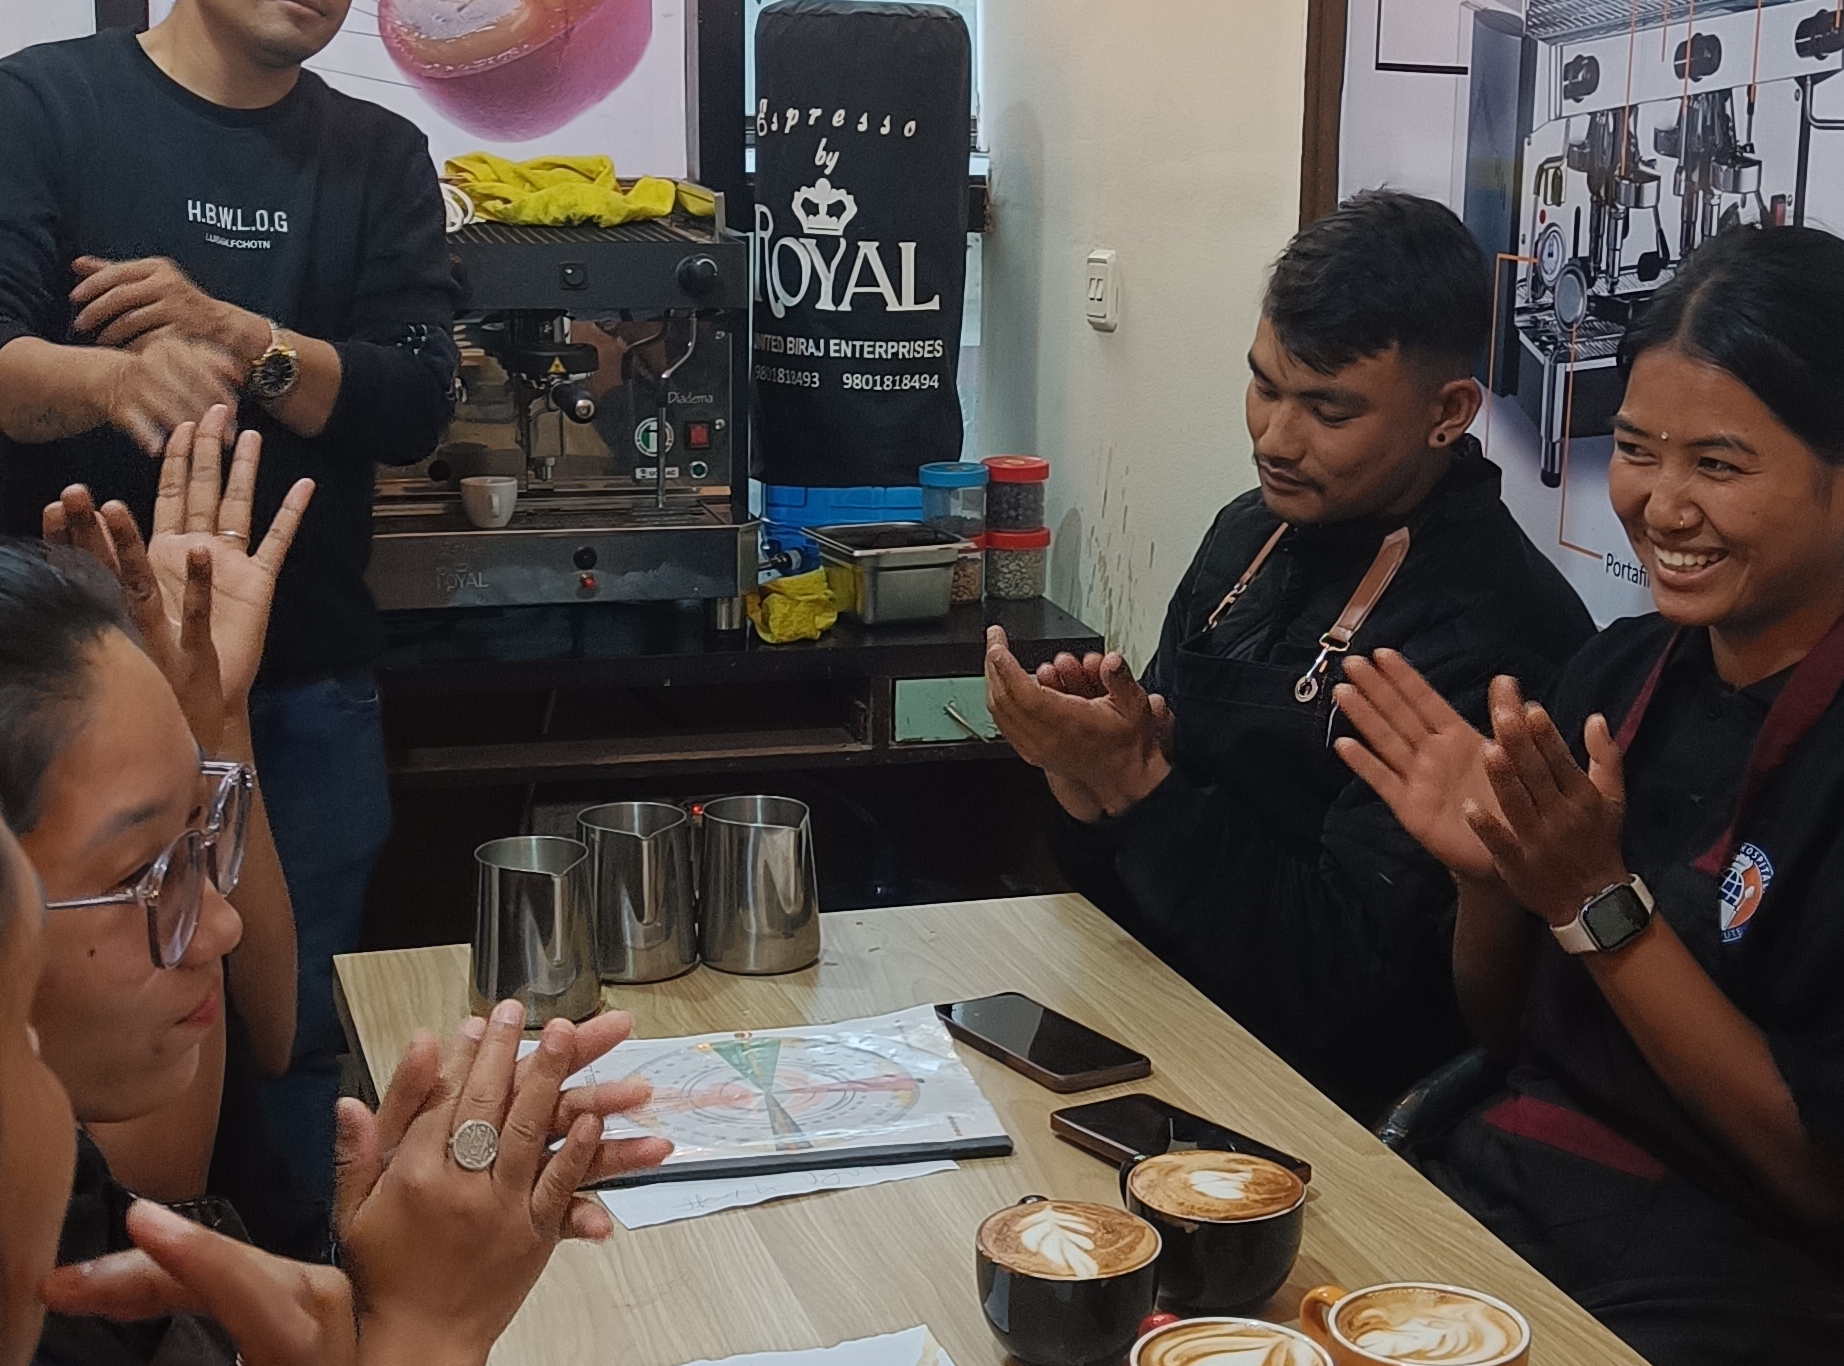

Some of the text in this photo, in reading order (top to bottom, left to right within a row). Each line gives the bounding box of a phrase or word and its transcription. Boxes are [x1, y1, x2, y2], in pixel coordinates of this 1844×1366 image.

[814, 137, 840, 175] by
[186, 199, 289, 234] H.B.W.L.O.G
[754, 202, 941, 319] ROYAL
[786, 336, 825, 357] BIRAJ
[828, 338, 944, 359] ENTERPRISES
[842, 373, 940, 391] 9801818494
